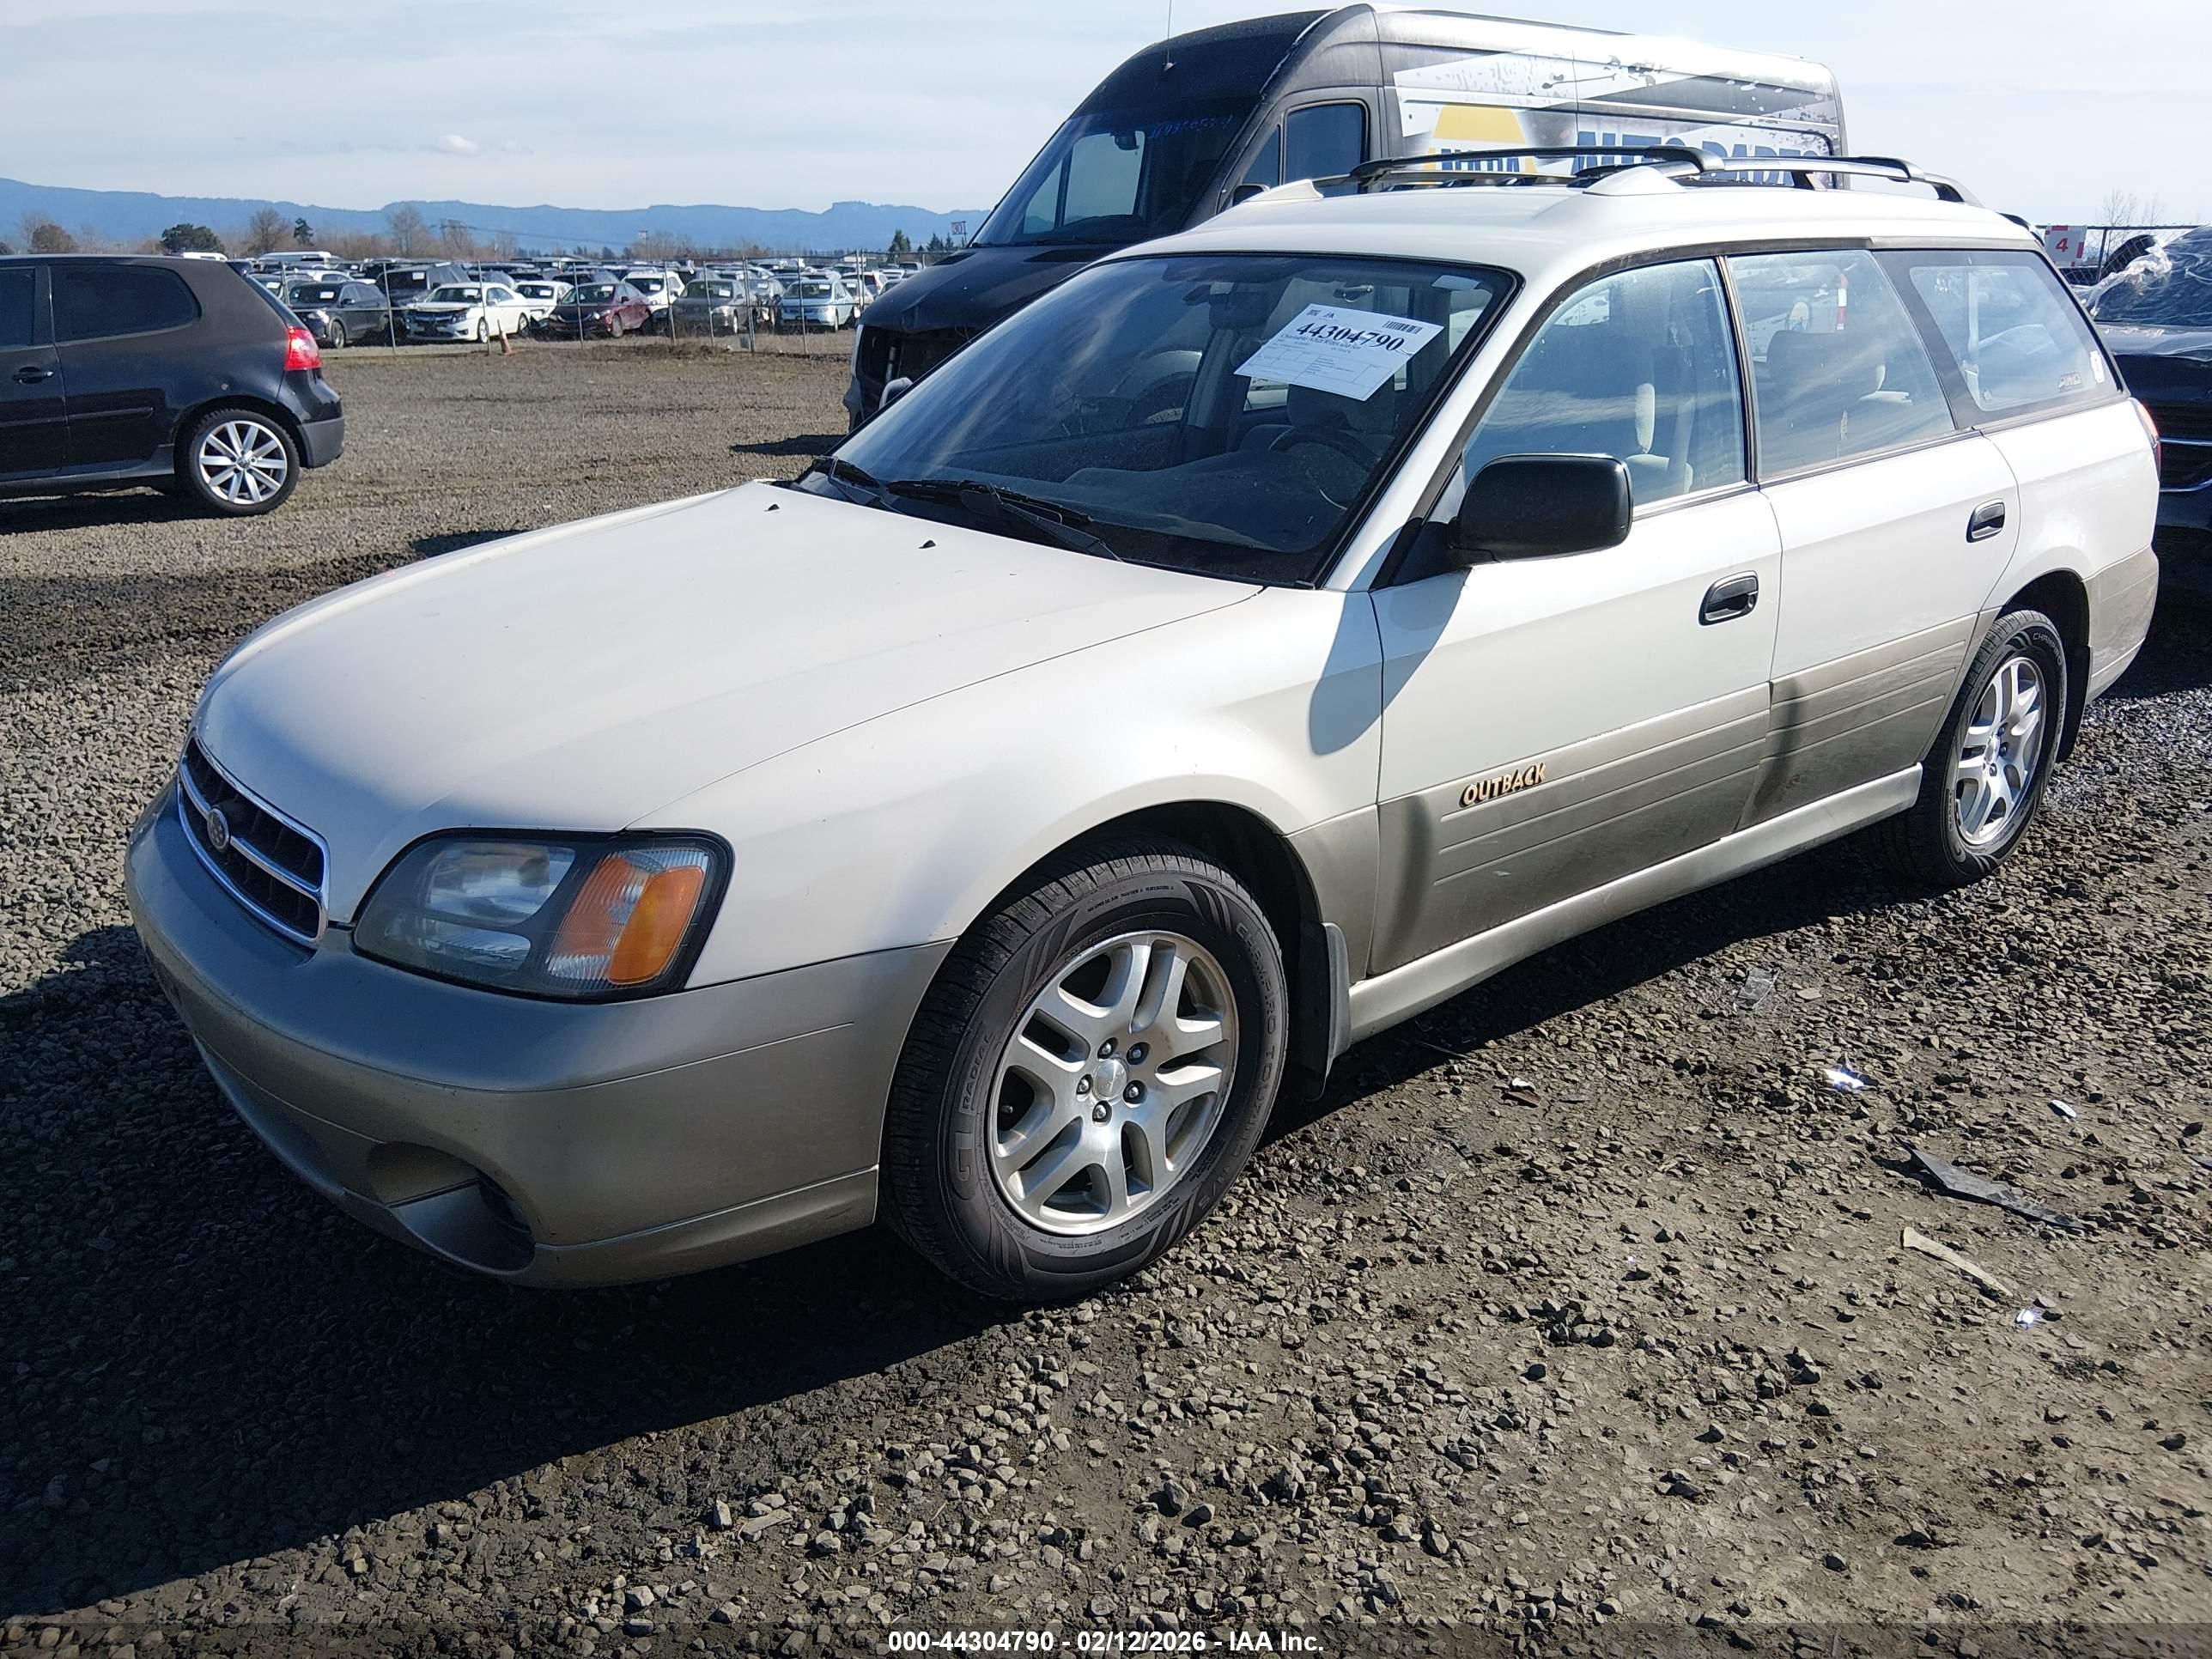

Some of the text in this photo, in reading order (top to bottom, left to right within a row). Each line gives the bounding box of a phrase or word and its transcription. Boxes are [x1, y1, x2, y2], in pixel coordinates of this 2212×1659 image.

[2055, 238, 2069, 252] 4
[1296, 322, 1406, 351] 44304790
[1459, 763, 1546, 807] OUTBACK
